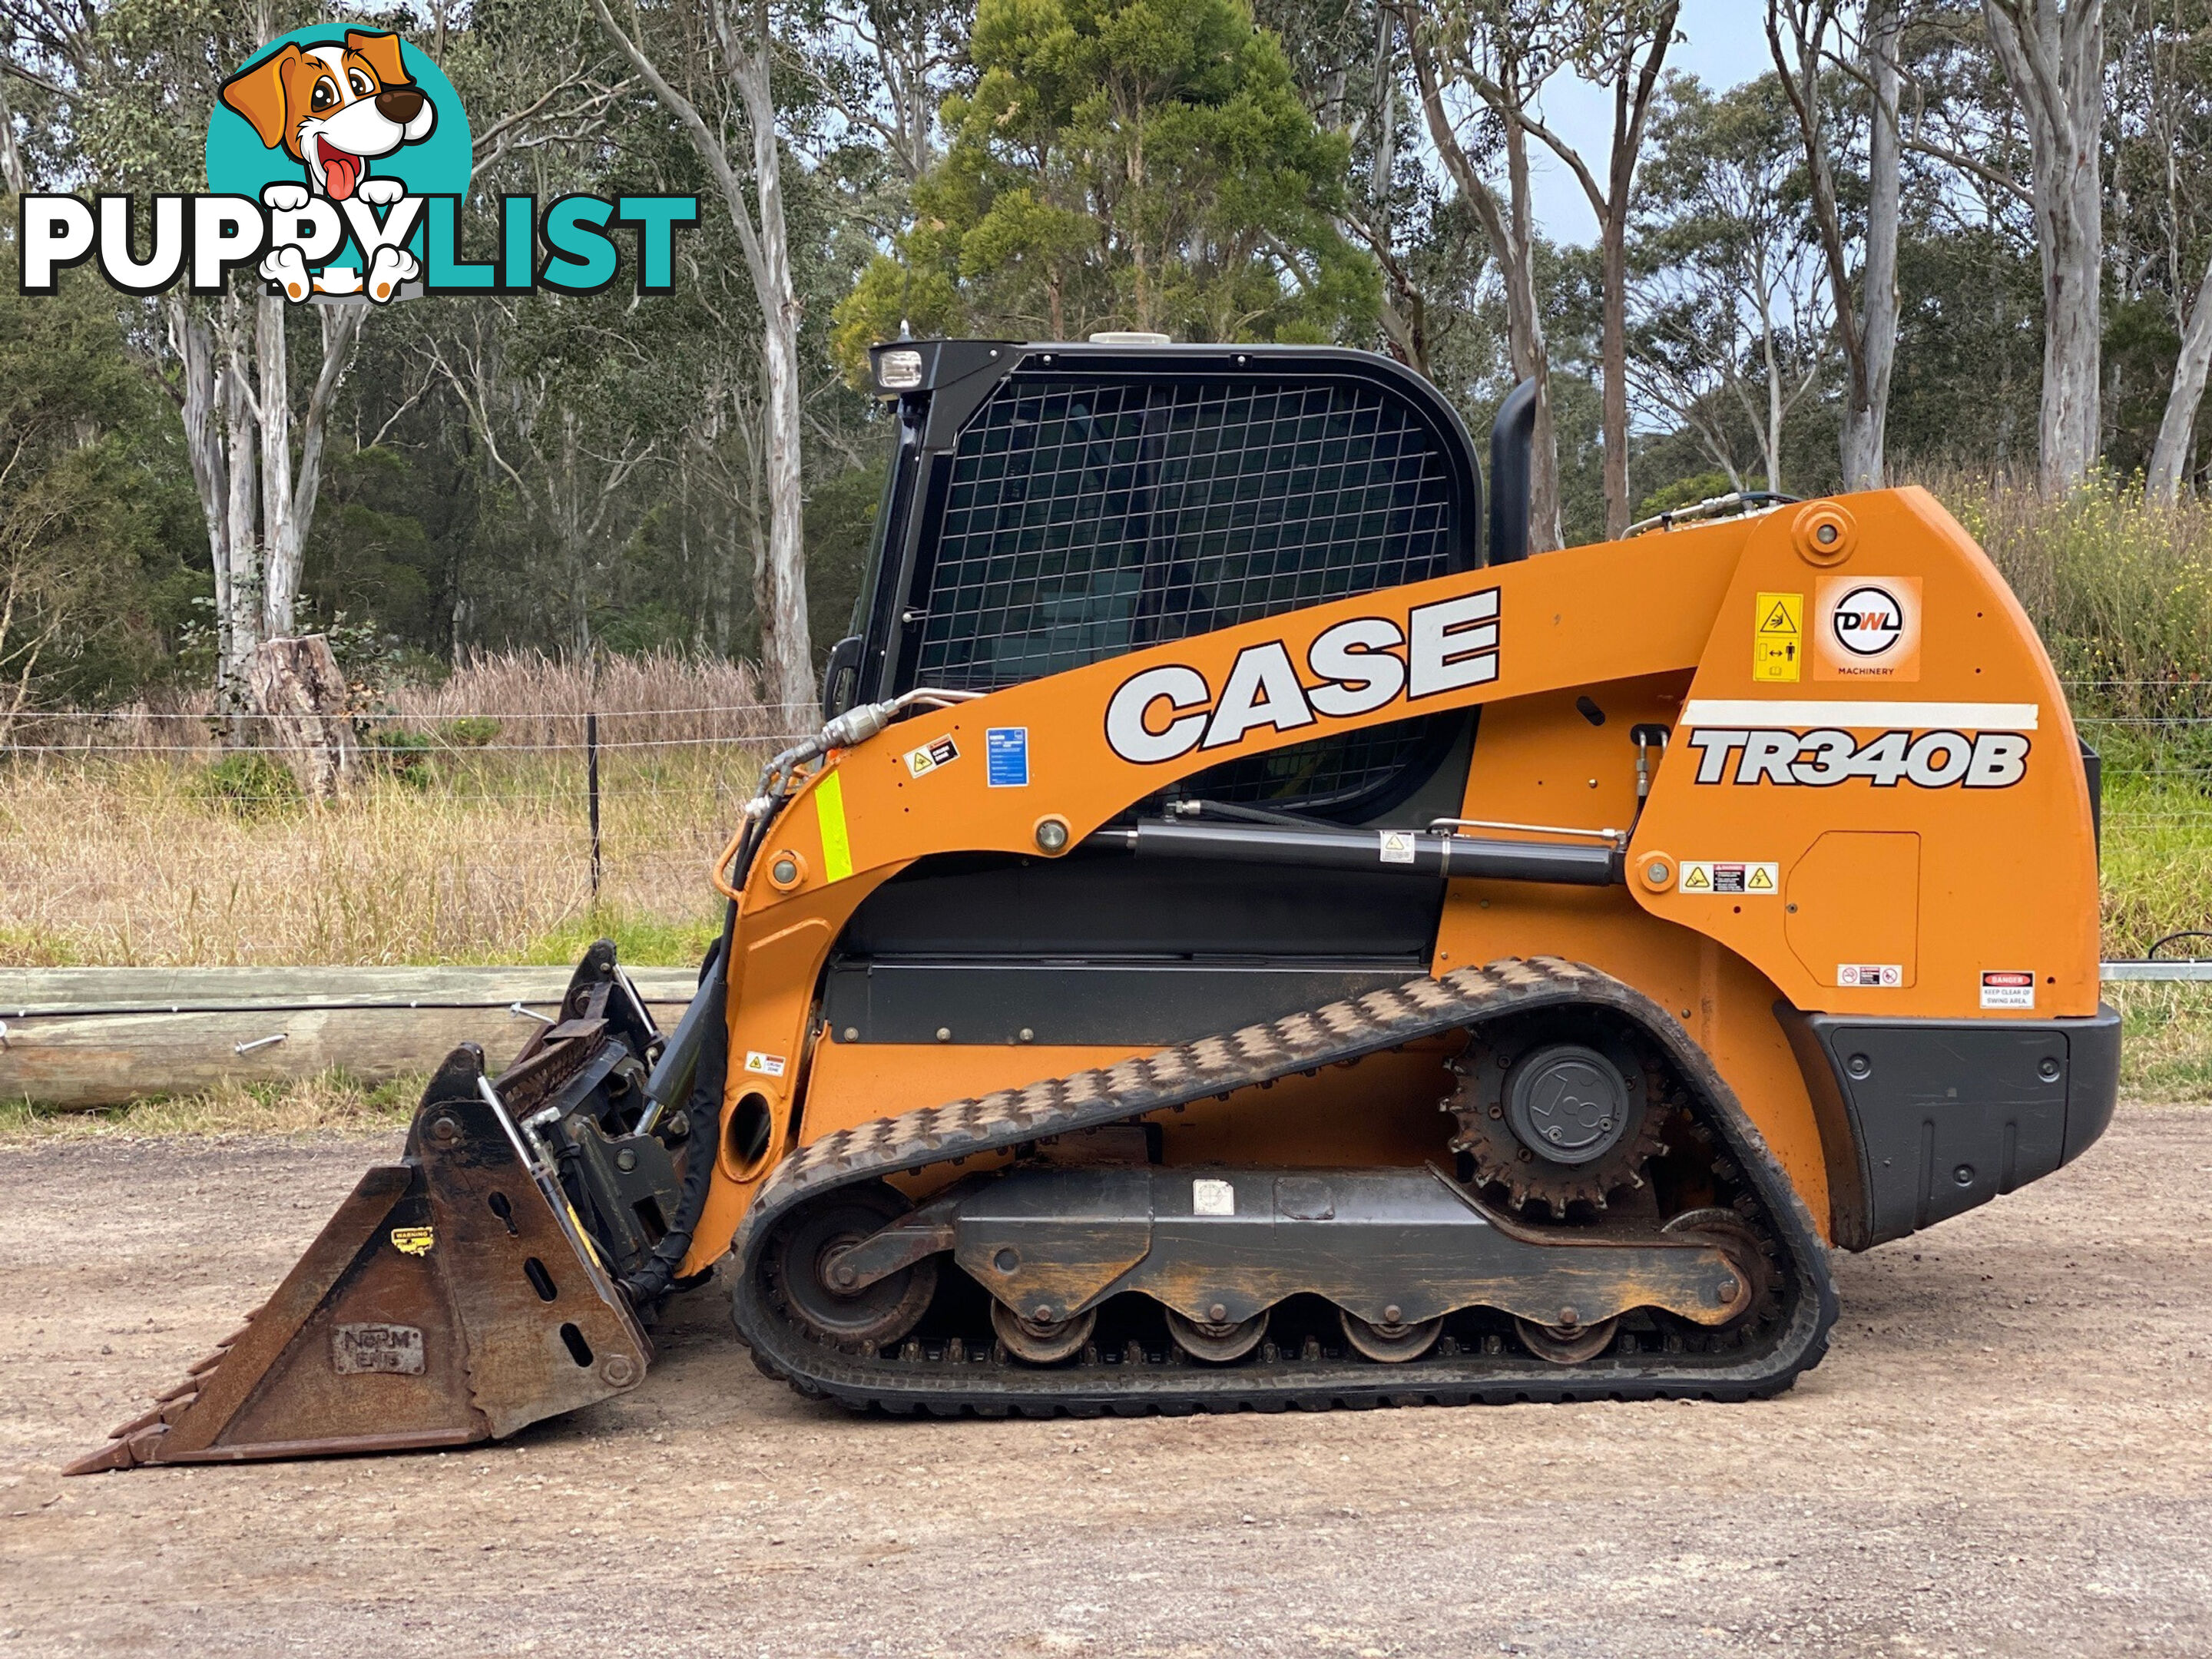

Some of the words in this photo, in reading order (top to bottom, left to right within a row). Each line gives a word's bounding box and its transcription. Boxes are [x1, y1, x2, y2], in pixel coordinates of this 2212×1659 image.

[1834, 612, 1902, 631] DWL
[1104, 586, 1501, 764] CASE
[1687, 728, 2032, 789] TR340B
